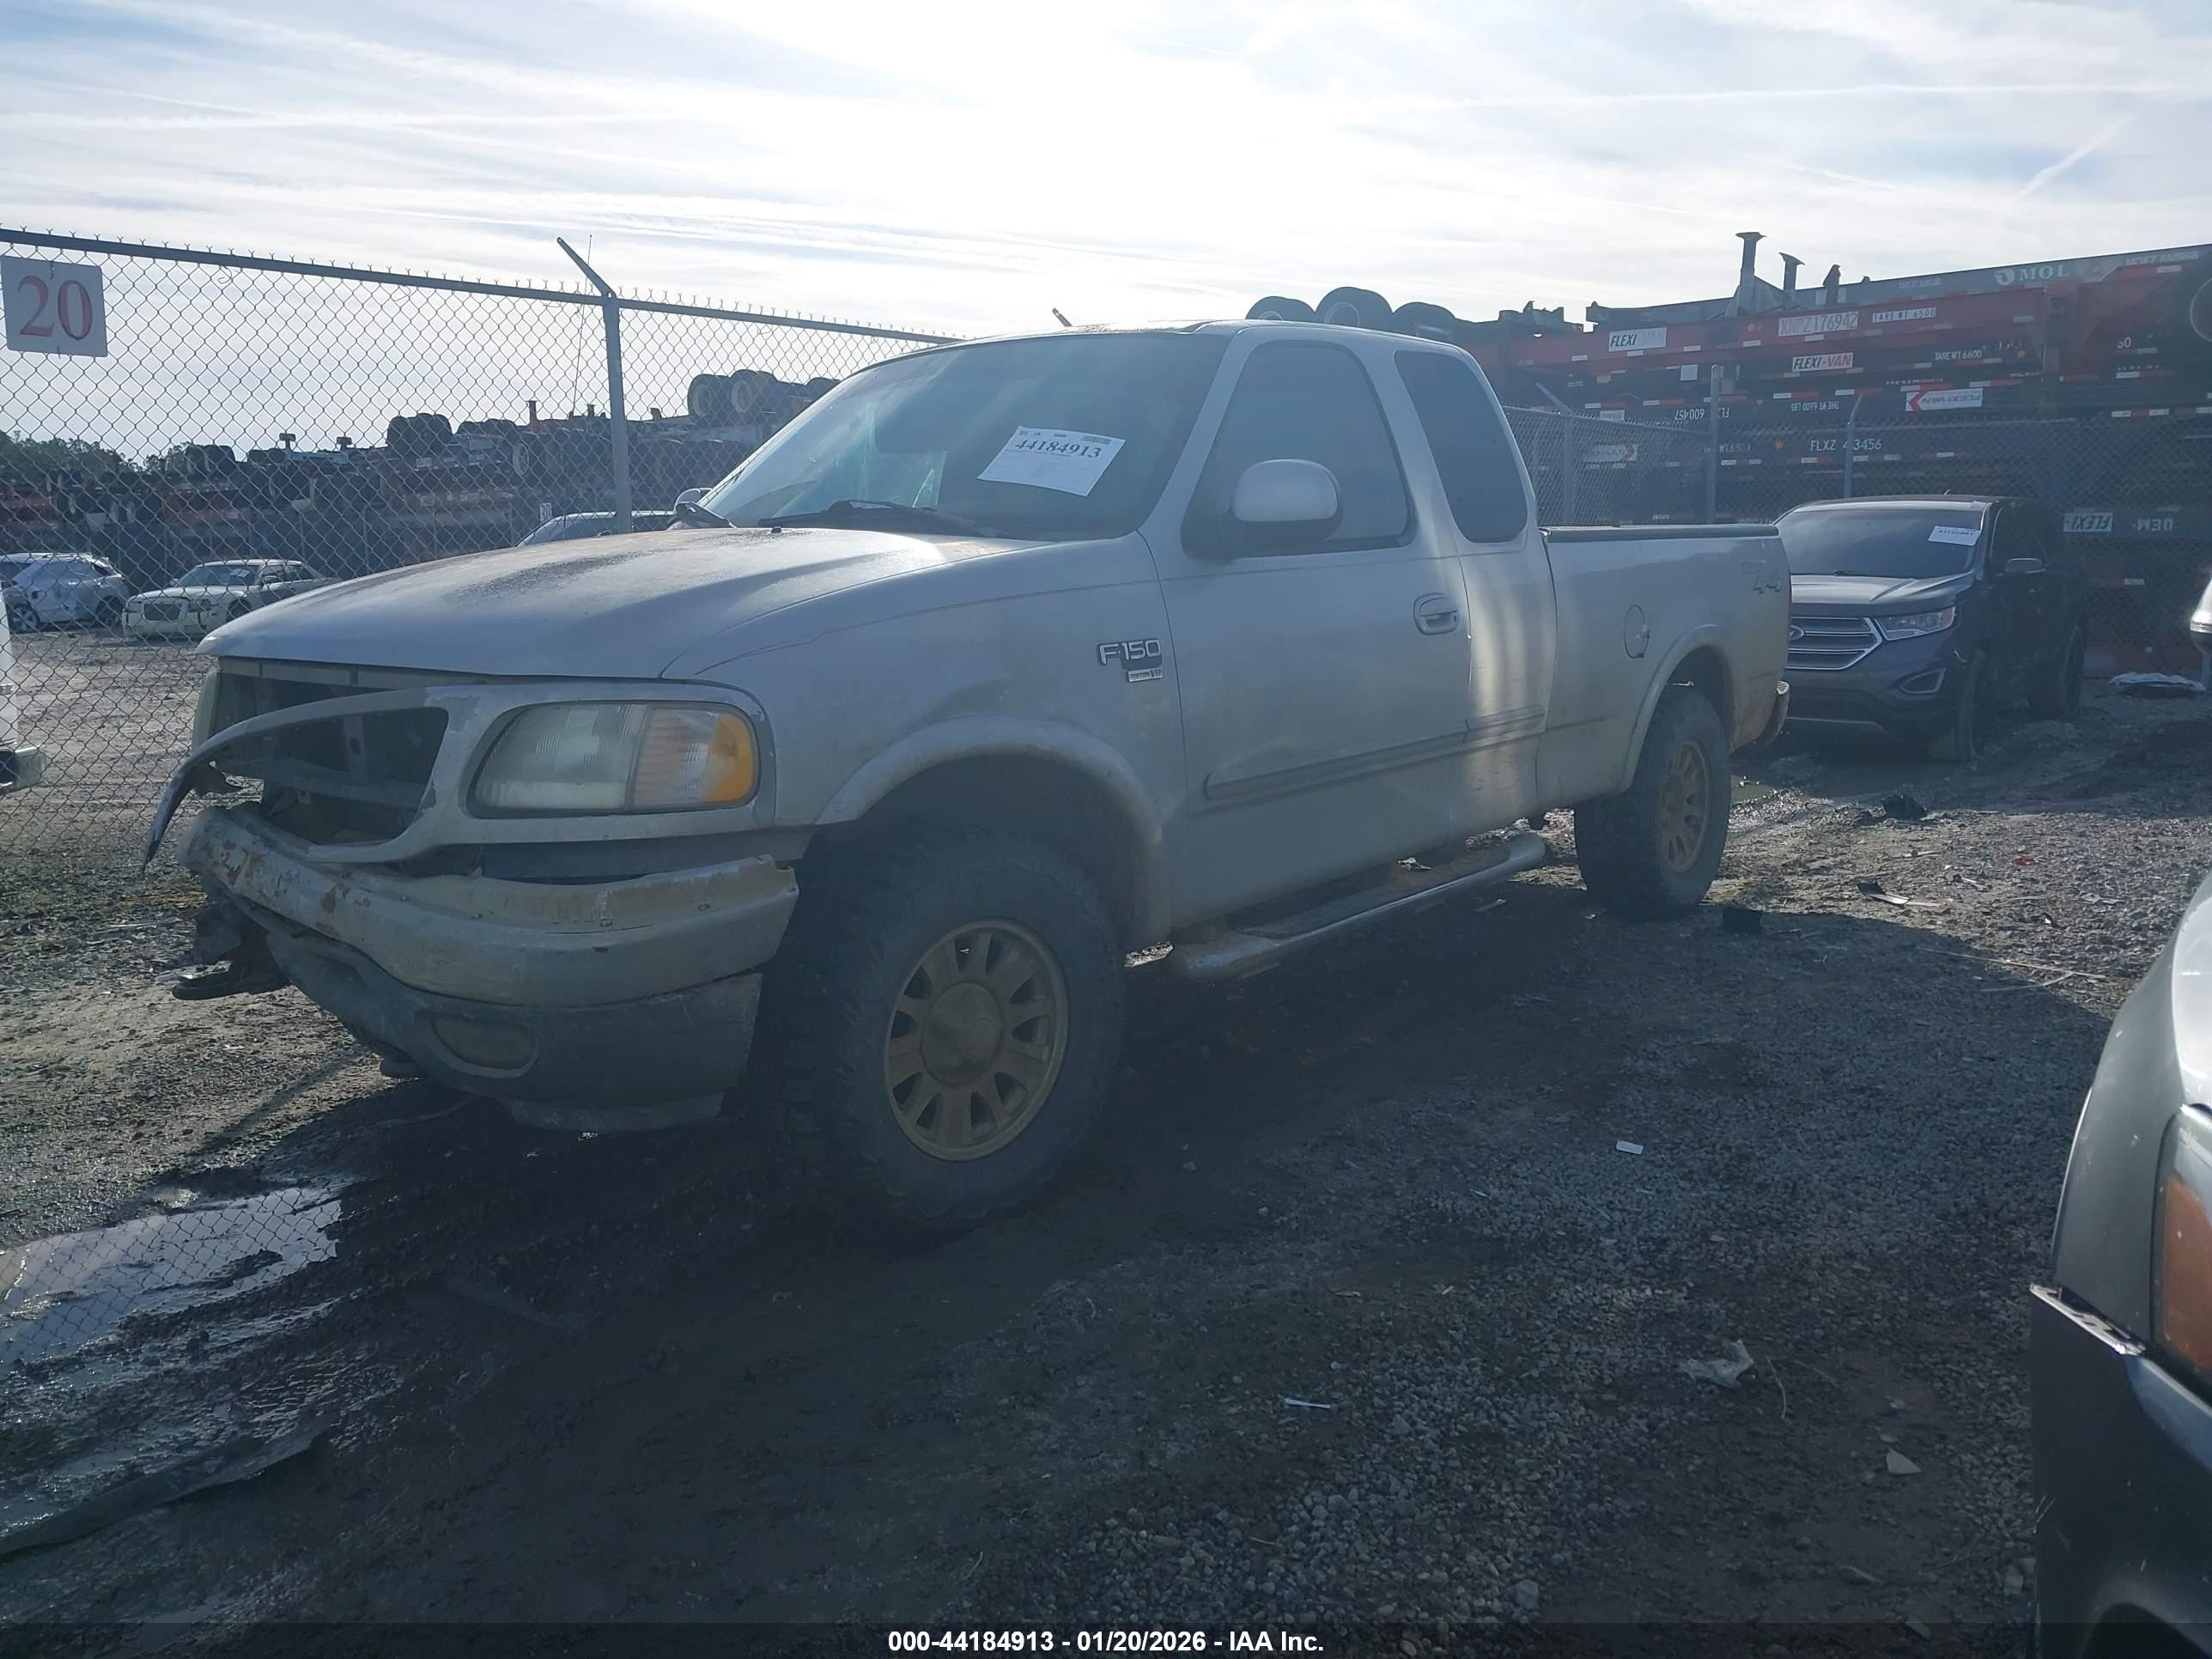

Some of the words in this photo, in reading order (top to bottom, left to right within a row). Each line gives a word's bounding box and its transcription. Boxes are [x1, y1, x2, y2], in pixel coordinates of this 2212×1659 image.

[2019, 264, 2069, 281] MOL
[17, 276, 93, 340] 20
[1794, 355, 1851, 370] FLEXI-VAN
[1015, 439, 1102, 459] 44184913
[1810, 439, 1837, 452] FLXZ
[1842, 438, 1882, 451] 43456
